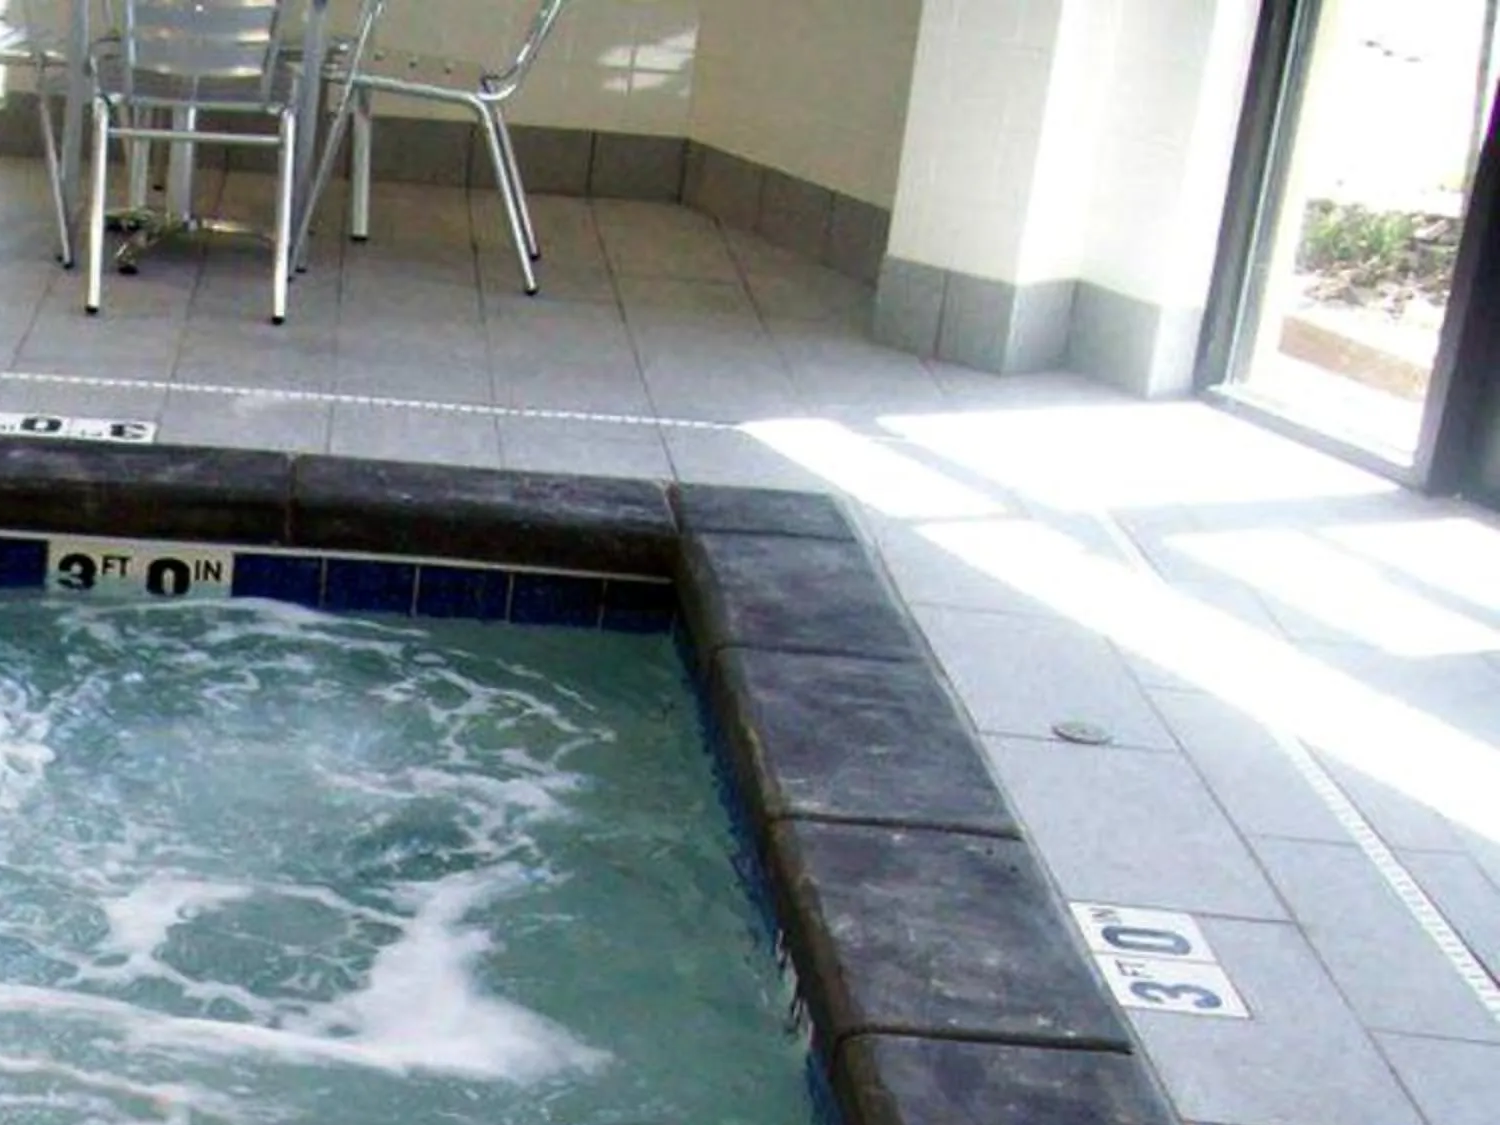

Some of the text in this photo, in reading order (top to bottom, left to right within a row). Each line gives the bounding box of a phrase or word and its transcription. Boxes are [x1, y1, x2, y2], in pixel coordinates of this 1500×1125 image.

[57, 552, 222, 597] 3 FT 0 IN
[1100, 925, 1192, 956] 0
[1129, 980, 1224, 1009] 3
